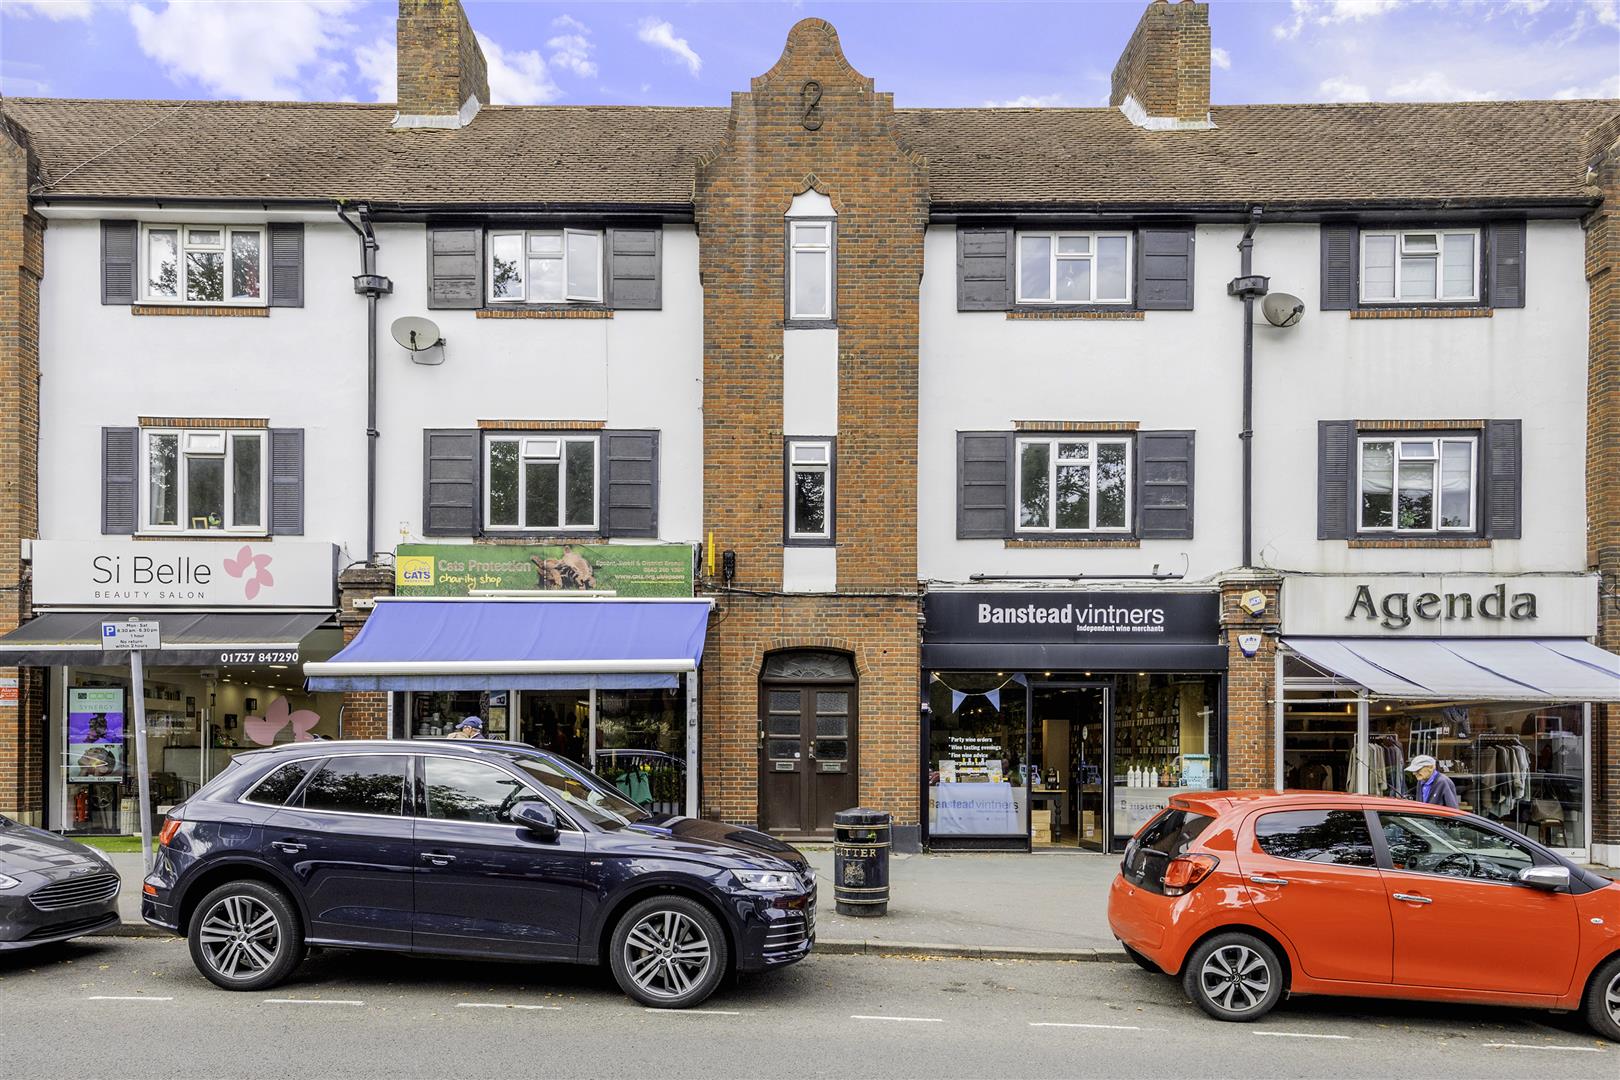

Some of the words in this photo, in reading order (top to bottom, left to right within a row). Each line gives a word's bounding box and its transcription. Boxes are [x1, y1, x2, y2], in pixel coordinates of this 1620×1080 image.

[93, 555, 120, 584] Si
[133, 556, 211, 584] Belle
[437, 559, 465, 572] Cats
[468, 559, 532, 572] Protection
[403, 571, 431, 579] CATS
[439, 573, 478, 590] charity
[479, 573, 502, 586] shop
[94, 591, 150, 599] BEAUTY
[159, 591, 205, 599] SALON
[1345, 583, 1538, 629] Agenda
[978, 604, 1073, 624] Banstead
[1075, 604, 1165, 624] vintners
[221, 653, 256, 662] 01737
[258, 652, 299, 662] 847290
[836, 848, 876, 857] LITTER
